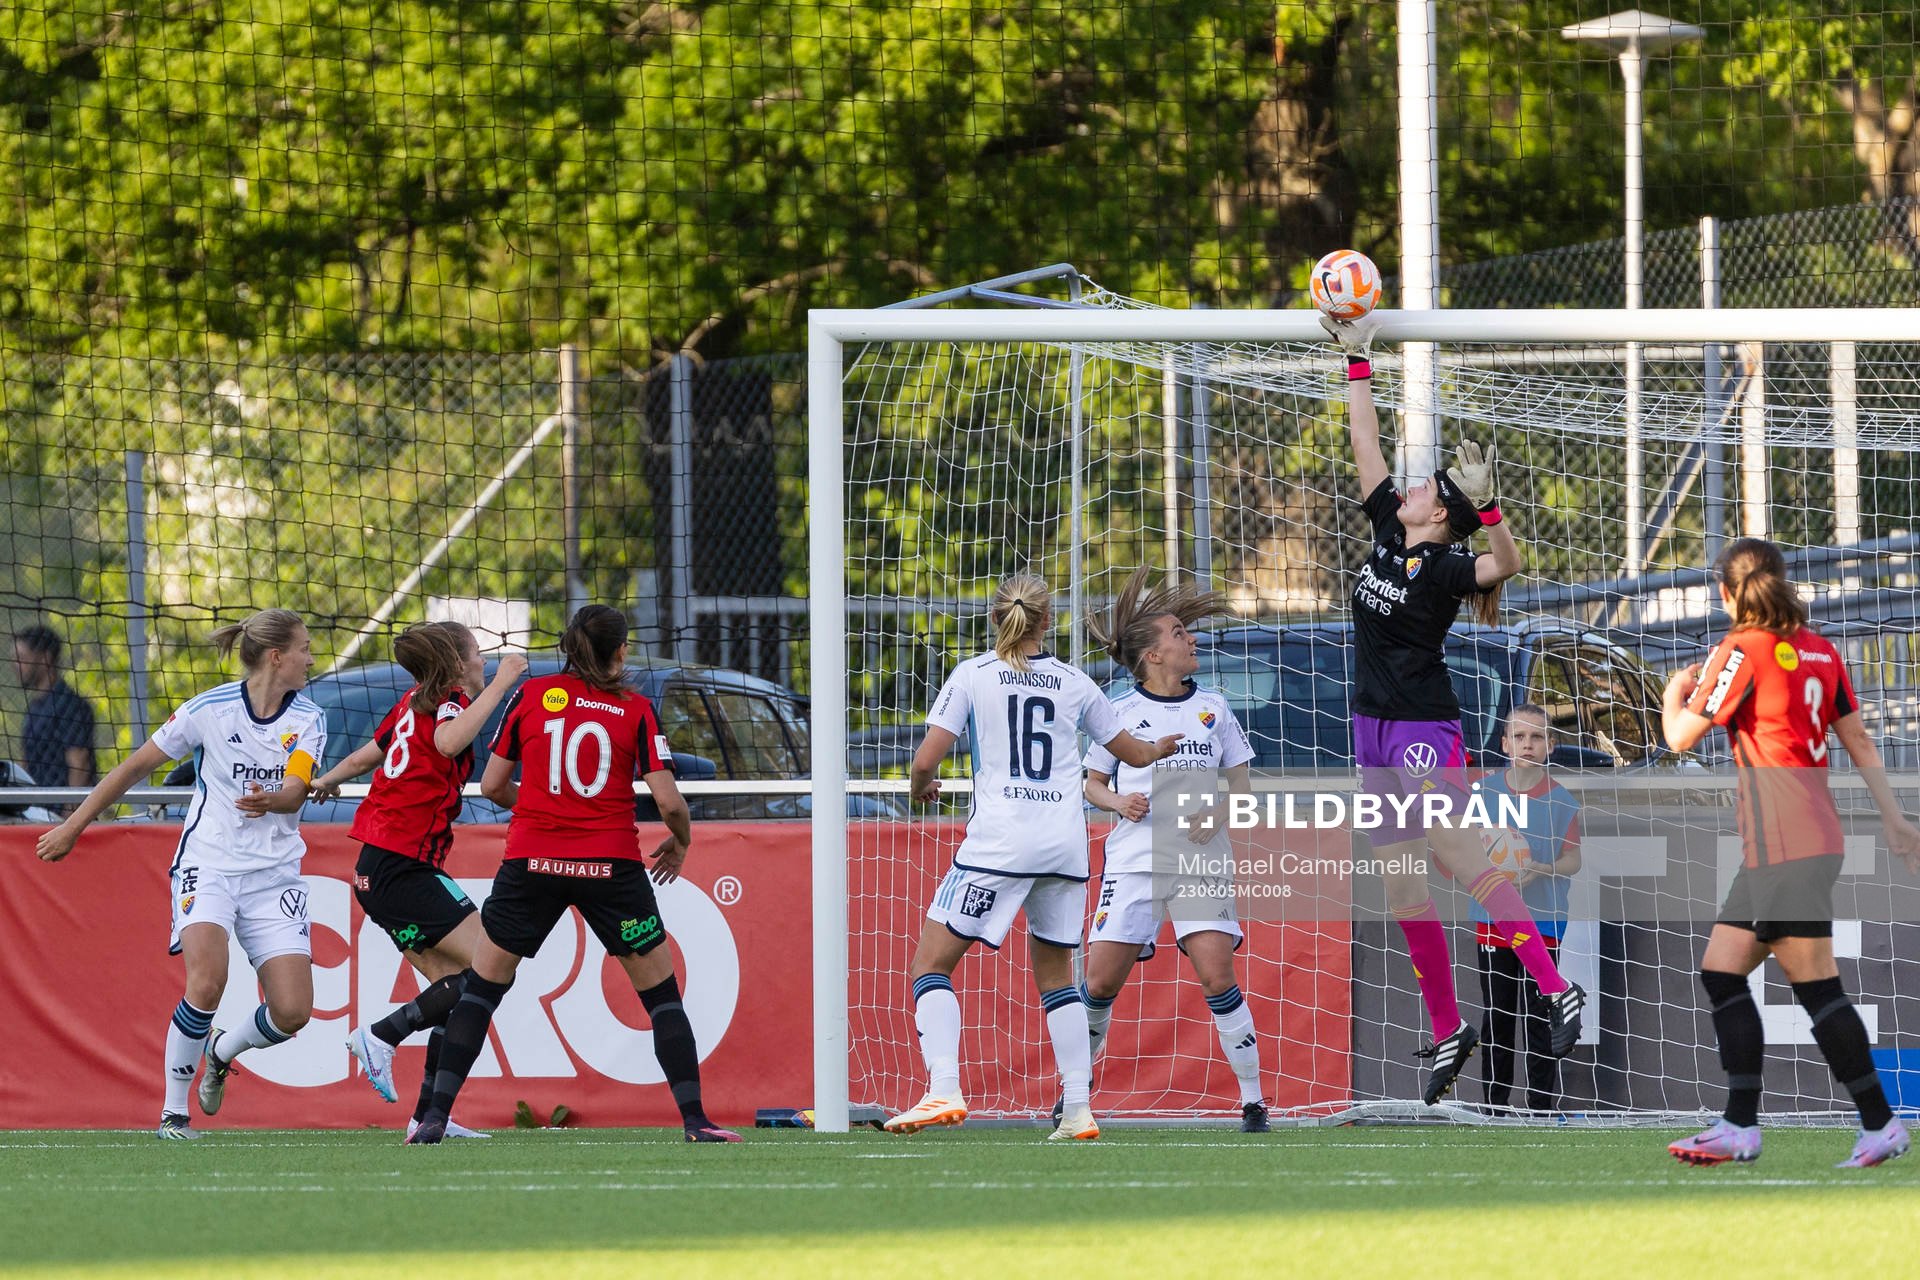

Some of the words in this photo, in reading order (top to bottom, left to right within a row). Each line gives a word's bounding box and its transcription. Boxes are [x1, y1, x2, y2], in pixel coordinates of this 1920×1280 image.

[1354, 582, 1392, 616] Finans
[1359, 564, 1408, 604] Prioritet
[998, 670, 1062, 691] JOHANSSON
[545, 694, 566, 706] Yale
[575, 697, 625, 717] Doorman
[1804, 676, 1827, 762] 3
[383, 708, 415, 779] 8
[1008, 694, 1055, 782] 16
[543, 717, 612, 798] 10
[1014, 787, 1062, 802] FXORO
[529, 859, 612, 878] BAUHAUS
[621, 915, 658, 942] coop
